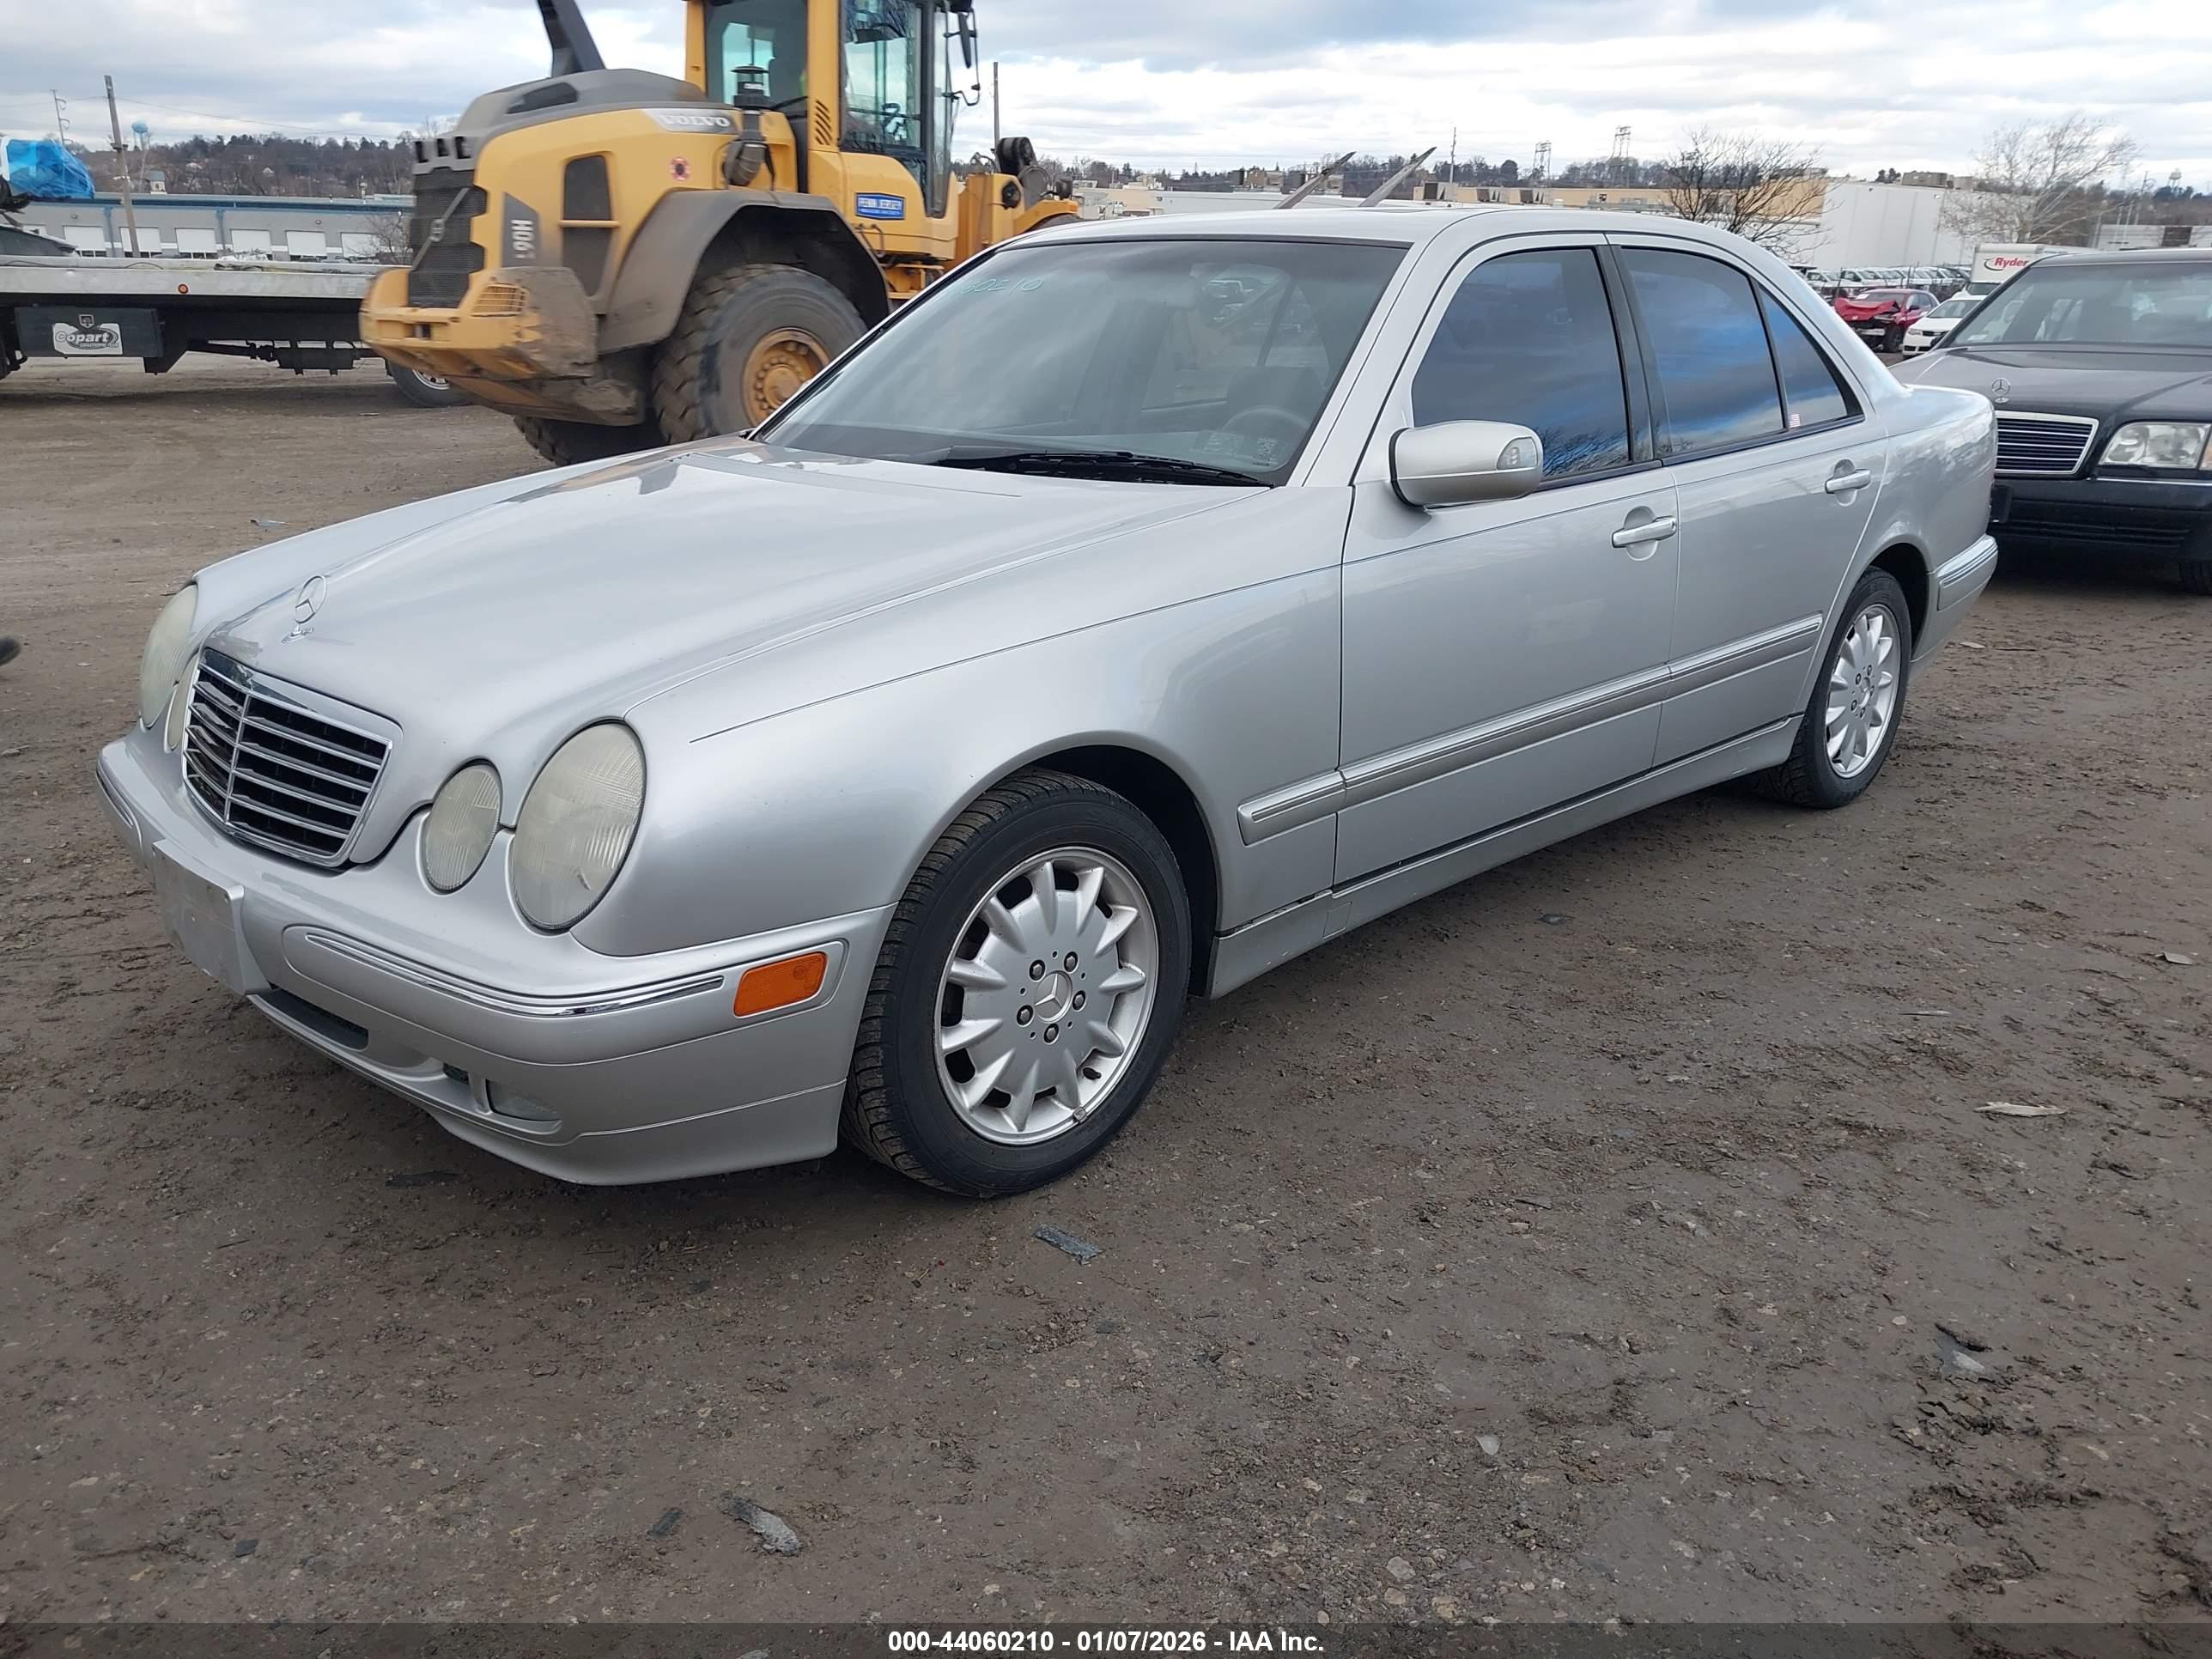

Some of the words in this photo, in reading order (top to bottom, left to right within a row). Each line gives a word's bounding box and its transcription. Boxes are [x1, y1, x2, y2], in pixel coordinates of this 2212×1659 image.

[658, 115, 731, 128] VOLVO
[1994, 257, 2029, 269] Ryder
[55, 331, 109, 343] Copart
